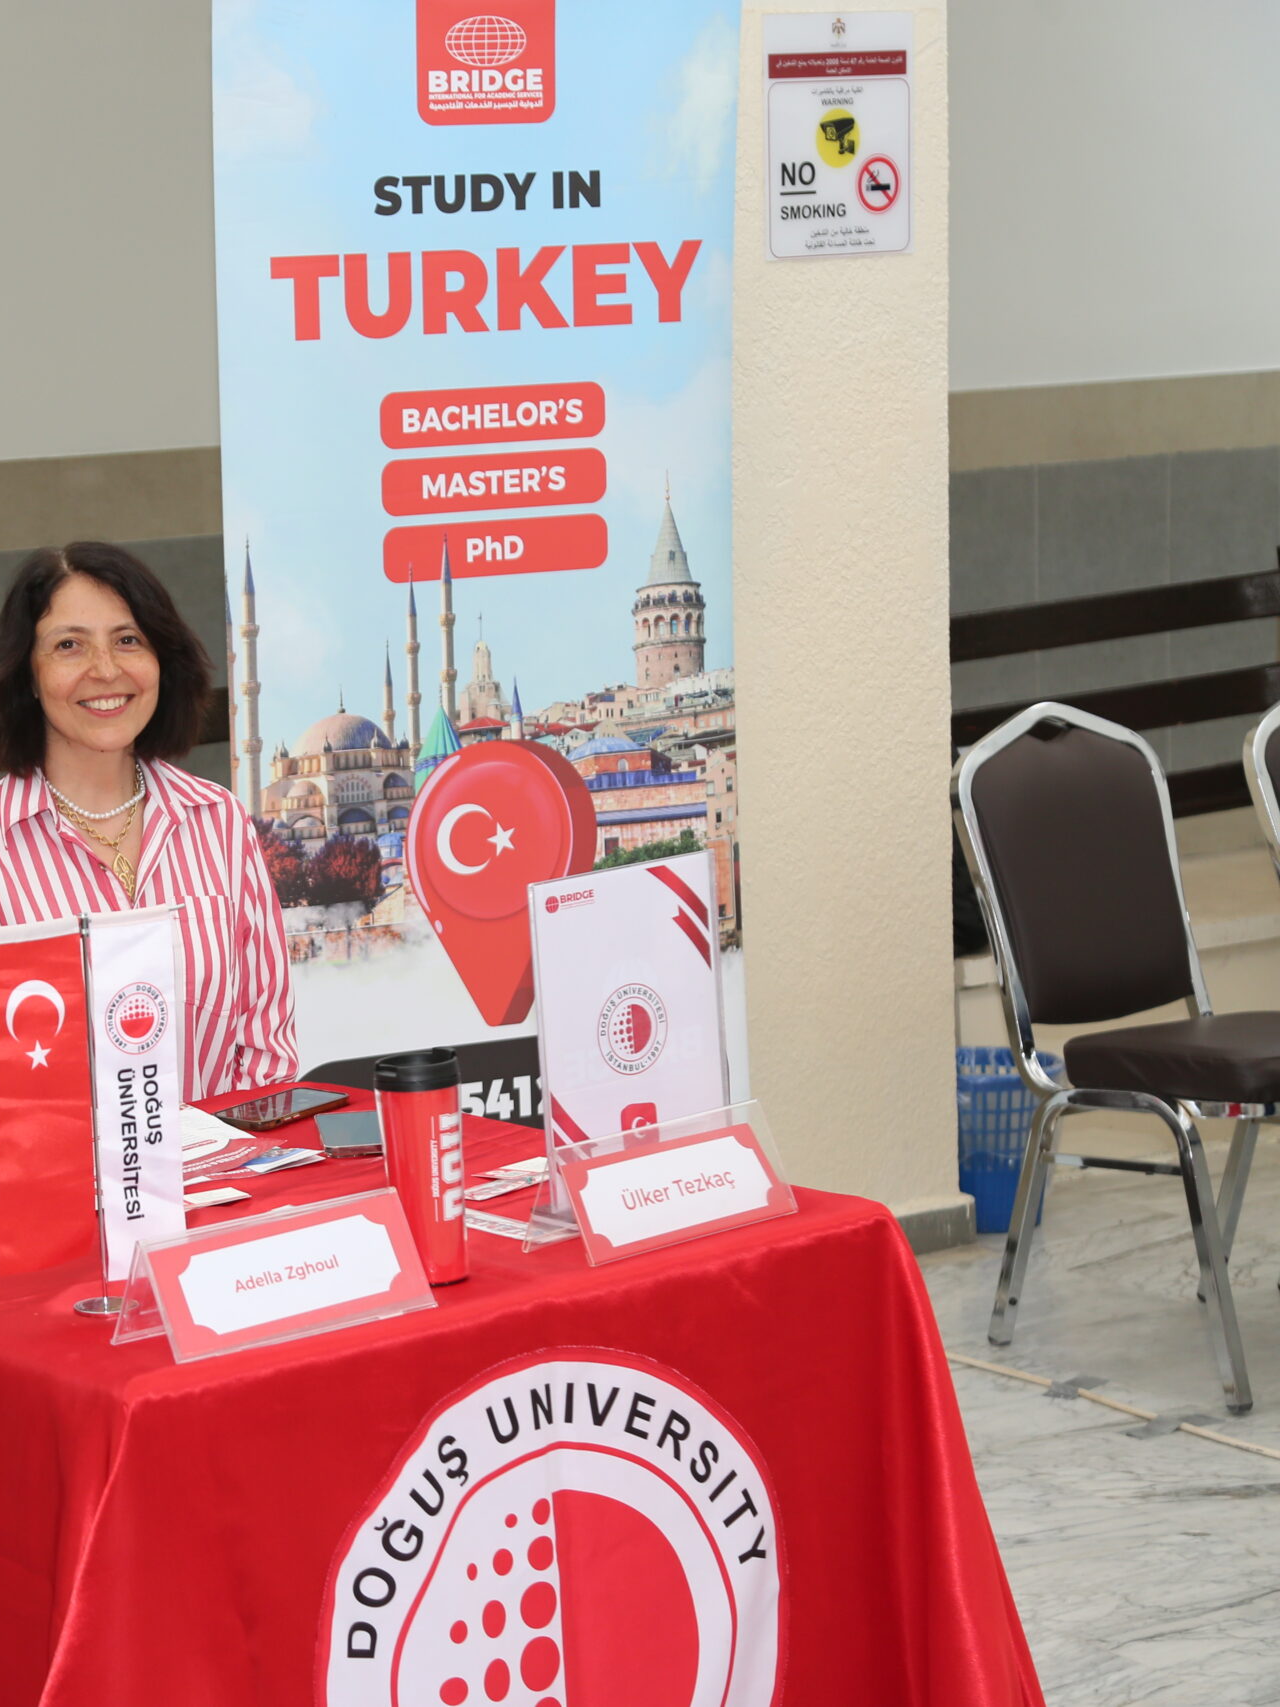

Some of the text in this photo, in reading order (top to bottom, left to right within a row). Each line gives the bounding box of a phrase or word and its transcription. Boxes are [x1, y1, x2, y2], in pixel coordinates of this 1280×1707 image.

[428, 68, 544, 92] BRIDGE
[821, 97, 854, 107] WARNING
[780, 161, 816, 187] NO
[373, 170, 601, 216] STUDY IN
[780, 202, 847, 220] SMOKING
[270, 240, 702, 341] TURKEY
[402, 399, 584, 433] BACHELOR’S
[422, 465, 567, 499] MASTER’S
[466, 535, 524, 563] PhD
[560, 889, 595, 904] BRIDGE
[142, 1064, 164, 1145] DOĞUŞ
[117, 1068, 145, 1221] ÜNİVERSİTESİ
[621, 1171, 736, 1211] Ülker Tezkaç
[235, 1254, 339, 1293] Adella Zghoul
[347, 1382, 767, 1659] DOĞUŞ UNIVERSITY
